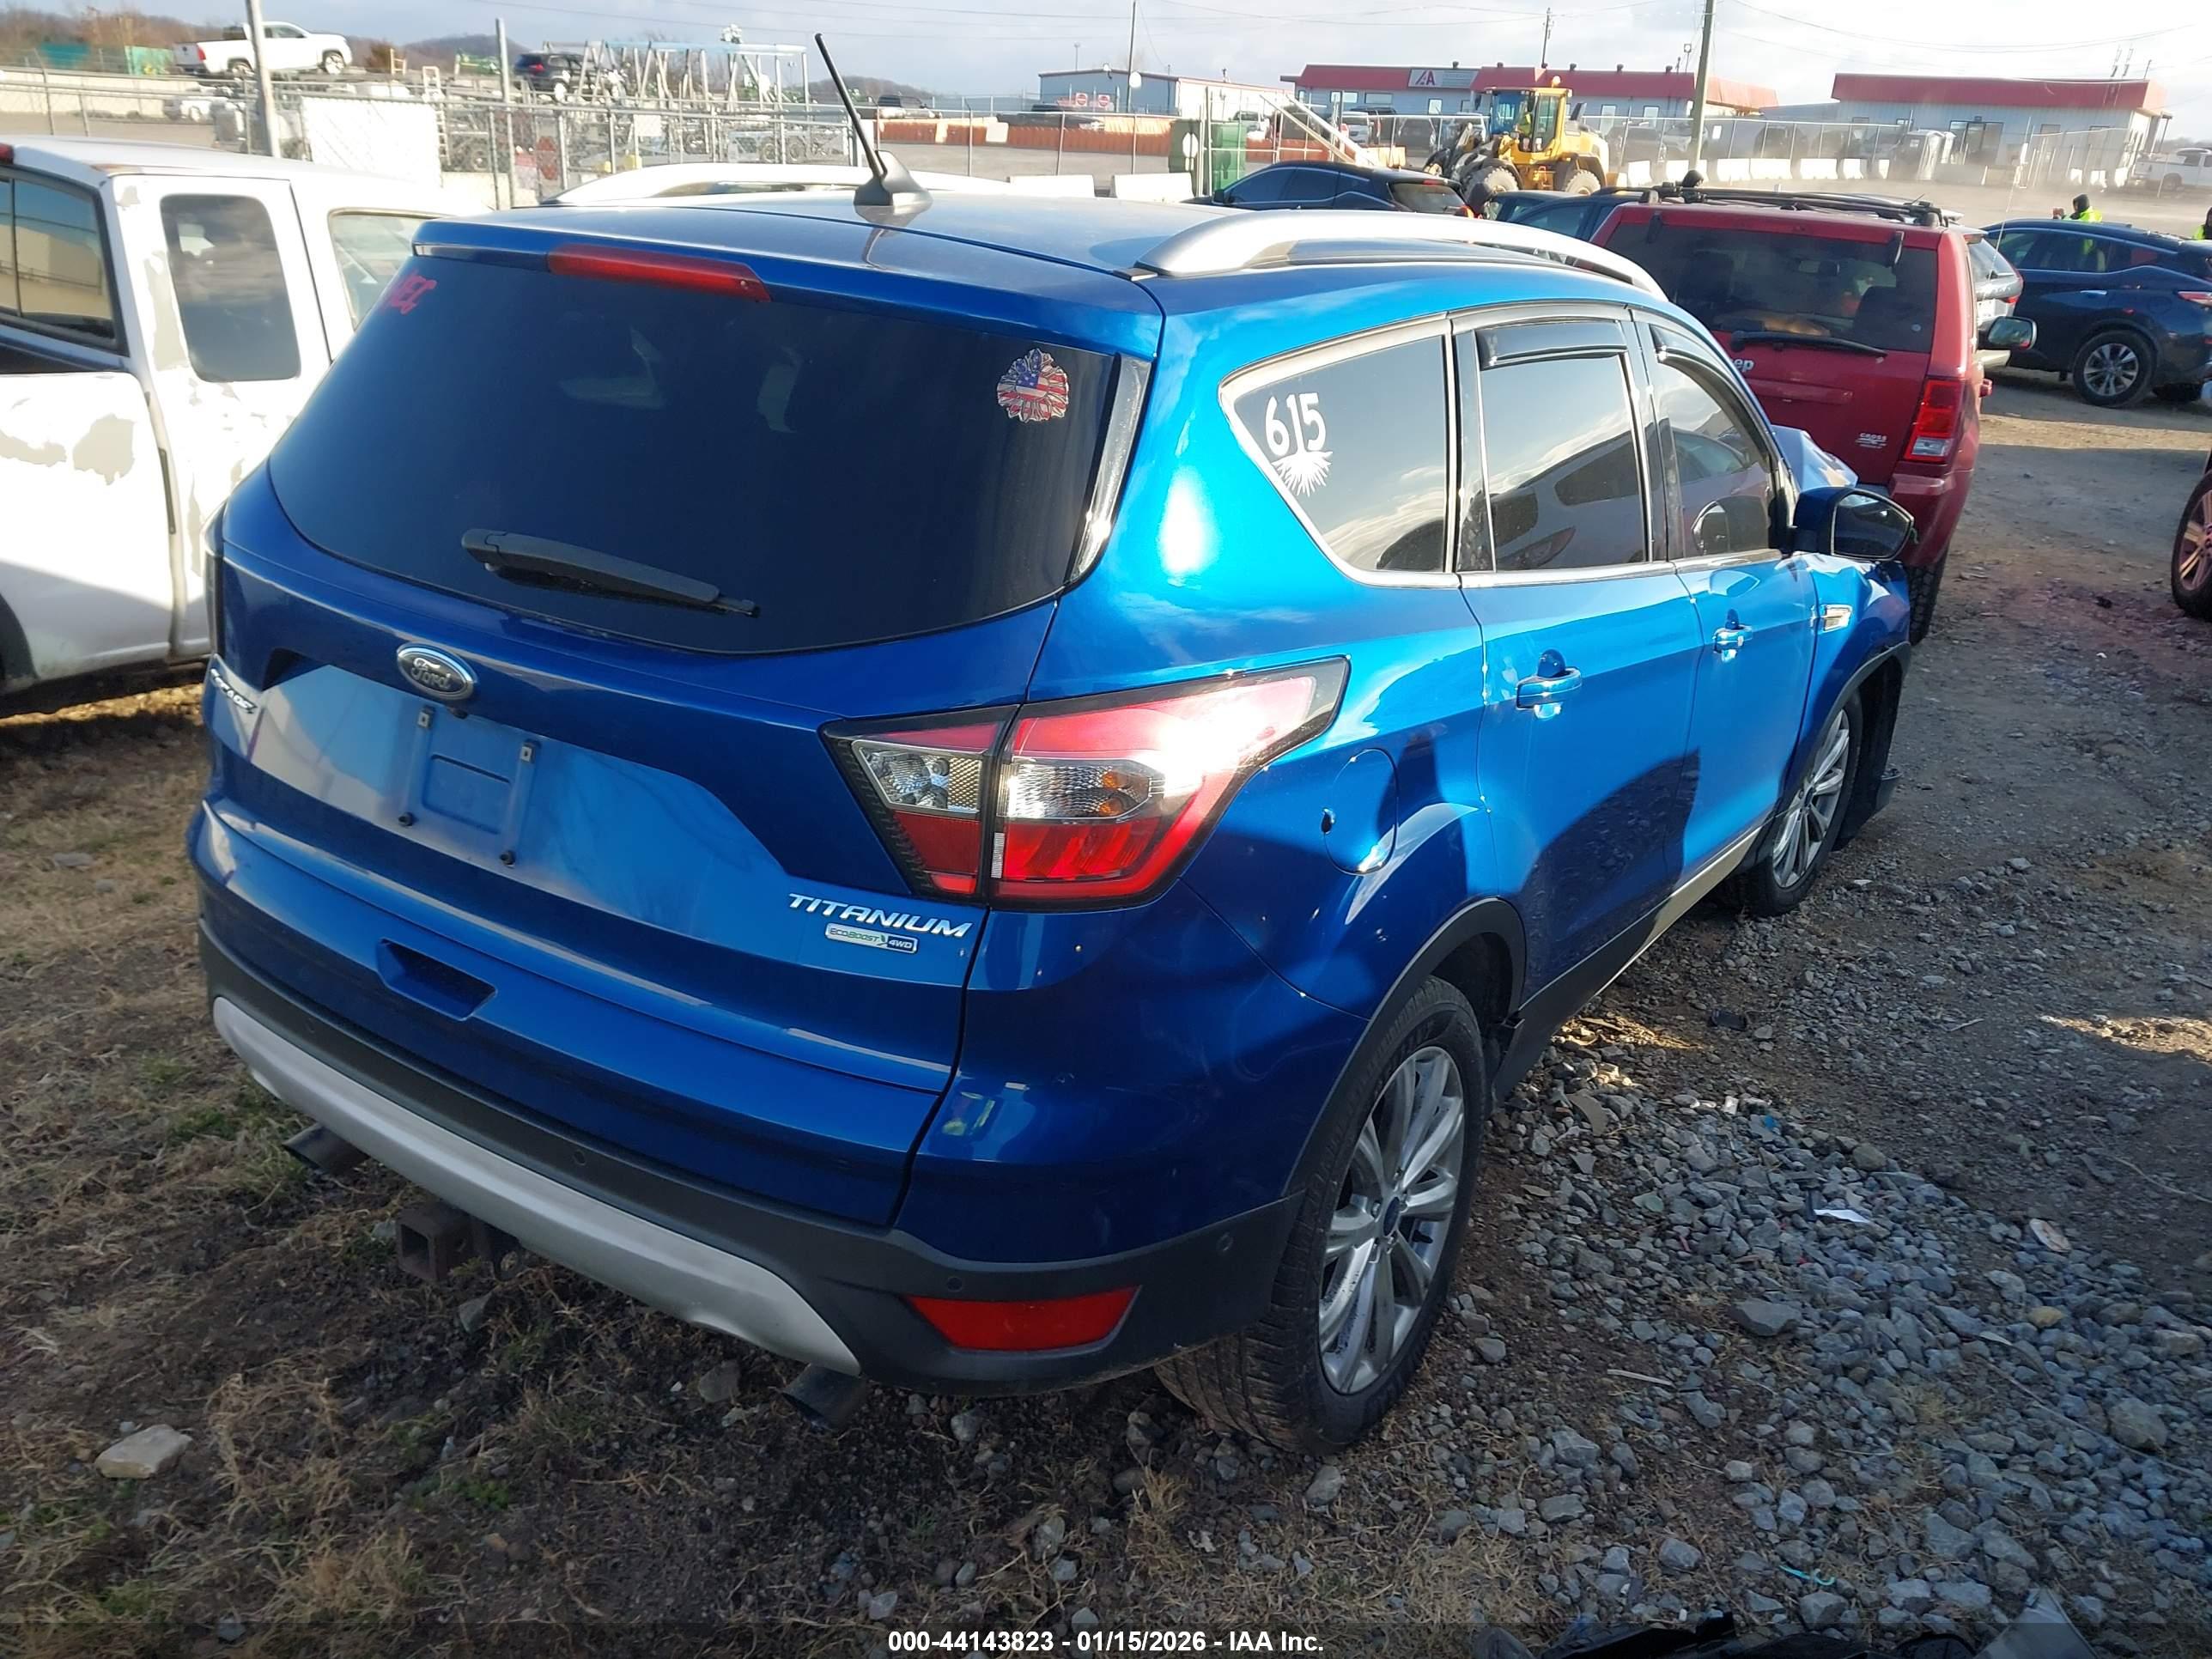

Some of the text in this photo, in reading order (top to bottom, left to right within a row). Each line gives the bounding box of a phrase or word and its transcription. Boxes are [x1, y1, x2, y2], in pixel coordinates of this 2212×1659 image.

[1265, 392, 1327, 457] 615
[410, 657, 453, 690] Ford
[788, 893, 974, 938] TITANIUM
[888, 939, 913, 949] 4WD
